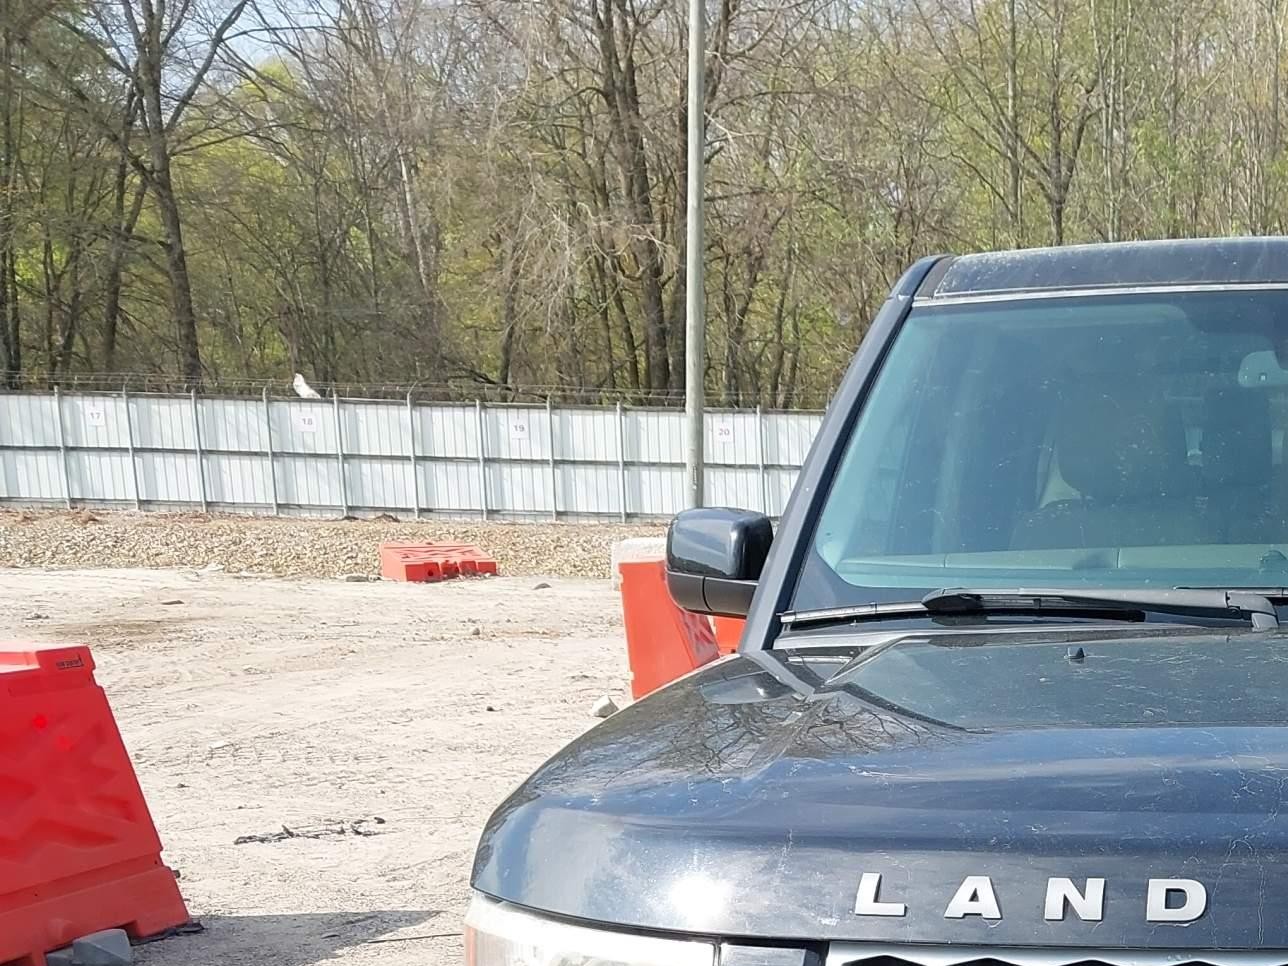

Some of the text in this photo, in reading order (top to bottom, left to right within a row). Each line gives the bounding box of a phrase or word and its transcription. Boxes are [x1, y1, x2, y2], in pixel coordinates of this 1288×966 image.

[513, 423, 525, 433] 19
[718, 427, 730, 437] 20
[855, 872, 1207, 922] LAND
